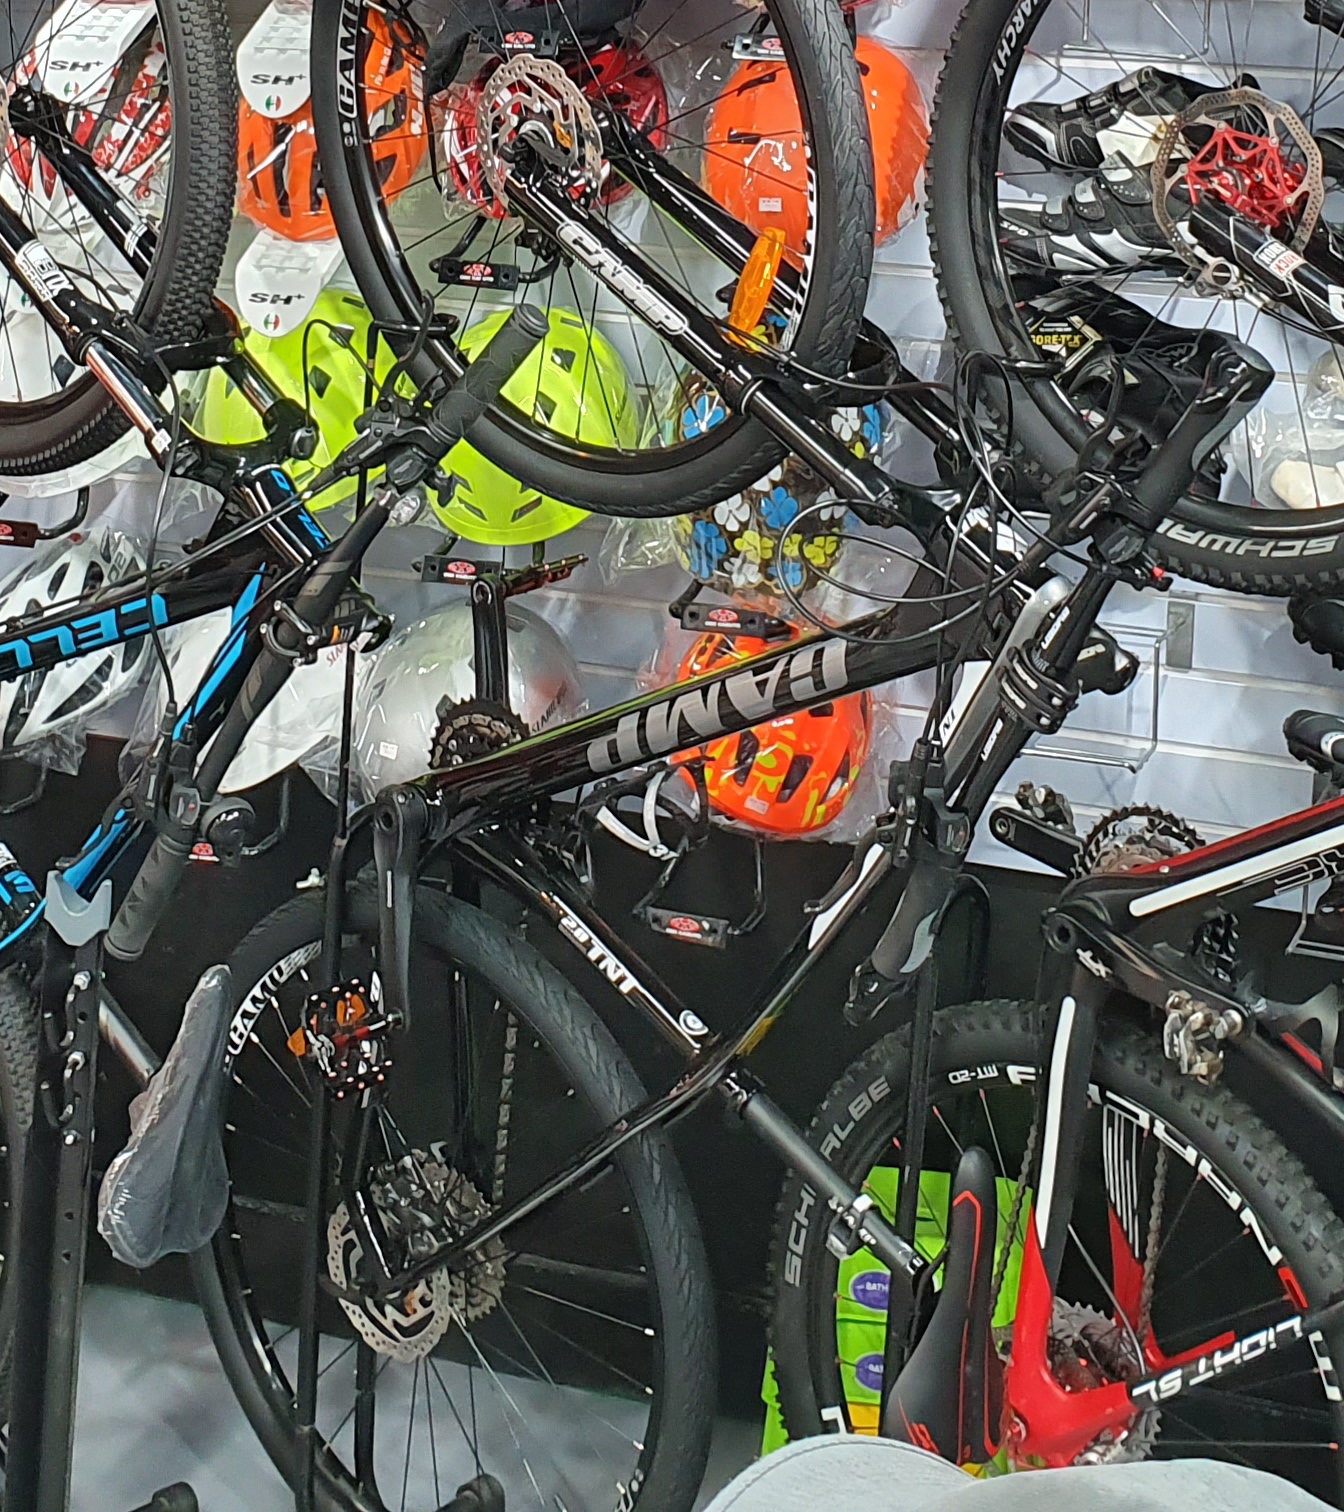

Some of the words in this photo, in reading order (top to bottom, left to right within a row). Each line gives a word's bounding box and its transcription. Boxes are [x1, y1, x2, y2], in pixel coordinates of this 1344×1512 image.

[48, 59, 104, 72] SH+
[247, 73, 306, 86] SH+
[247, 291, 306, 306] SH+
[585, 637, 848, 774] CAMP
[587, 944, 639, 995] TNT
[785, 1074, 892, 1290] SCHALBE
[1192, 1316, 1303, 1386] LIGHT
